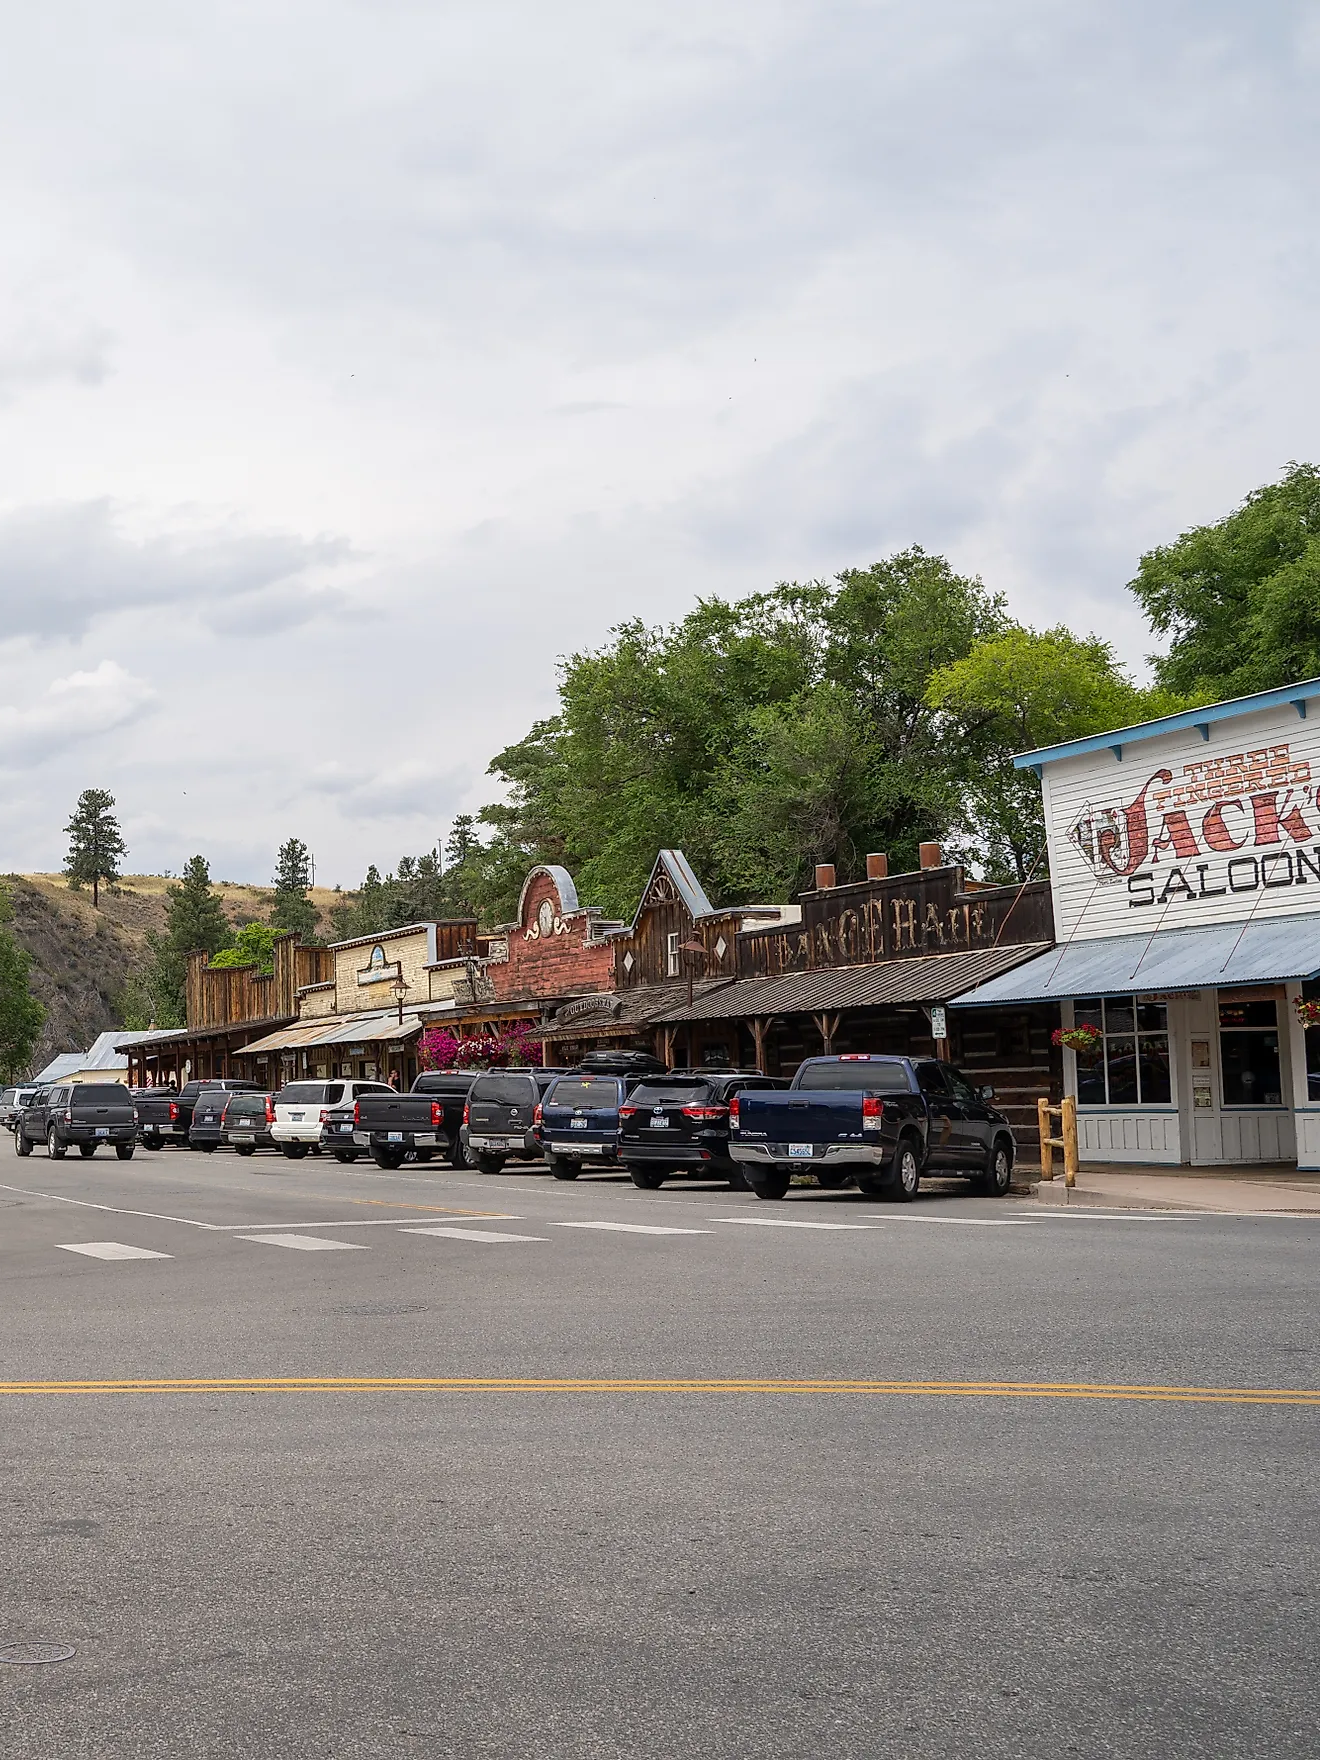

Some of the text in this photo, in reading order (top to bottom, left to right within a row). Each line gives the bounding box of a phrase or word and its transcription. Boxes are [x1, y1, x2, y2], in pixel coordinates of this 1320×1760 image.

[1152, 761, 1312, 812] FINGERED
[1183, 743, 1290, 784] THREE
[1097, 769, 1320, 876] JACK'
[1128, 847, 1320, 908] SALOON
